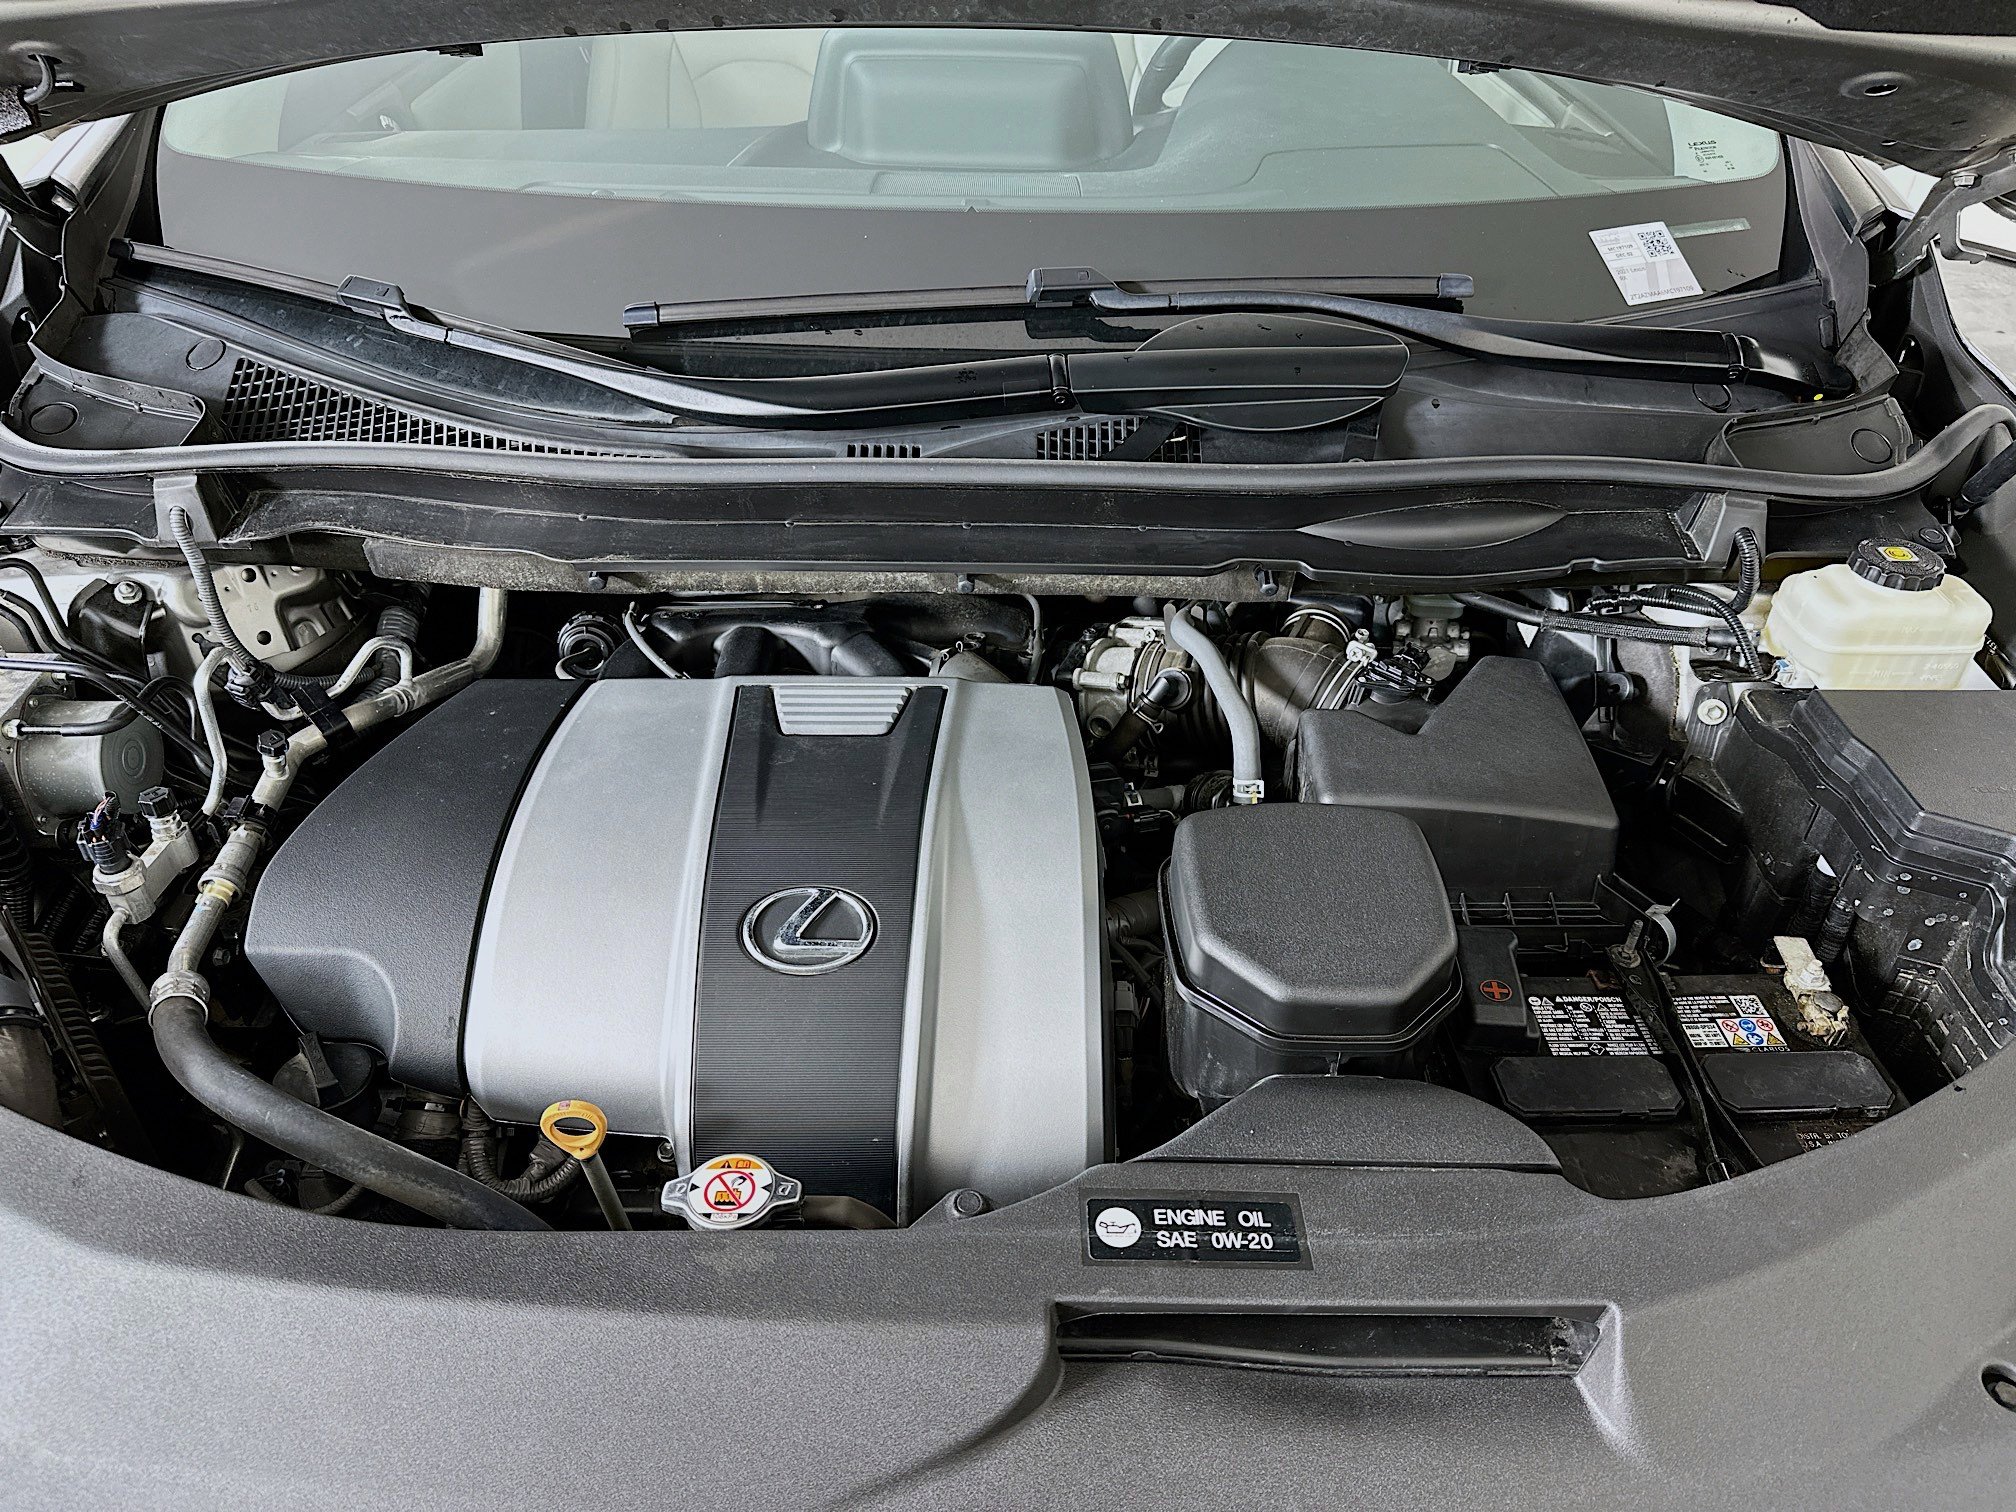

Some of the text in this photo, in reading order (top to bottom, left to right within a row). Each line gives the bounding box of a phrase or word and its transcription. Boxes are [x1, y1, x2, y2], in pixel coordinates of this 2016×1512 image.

[1153, 1208, 1272, 1228] ENGINE OIL
[1156, 1231, 1274, 1250] SAE 0W-20
